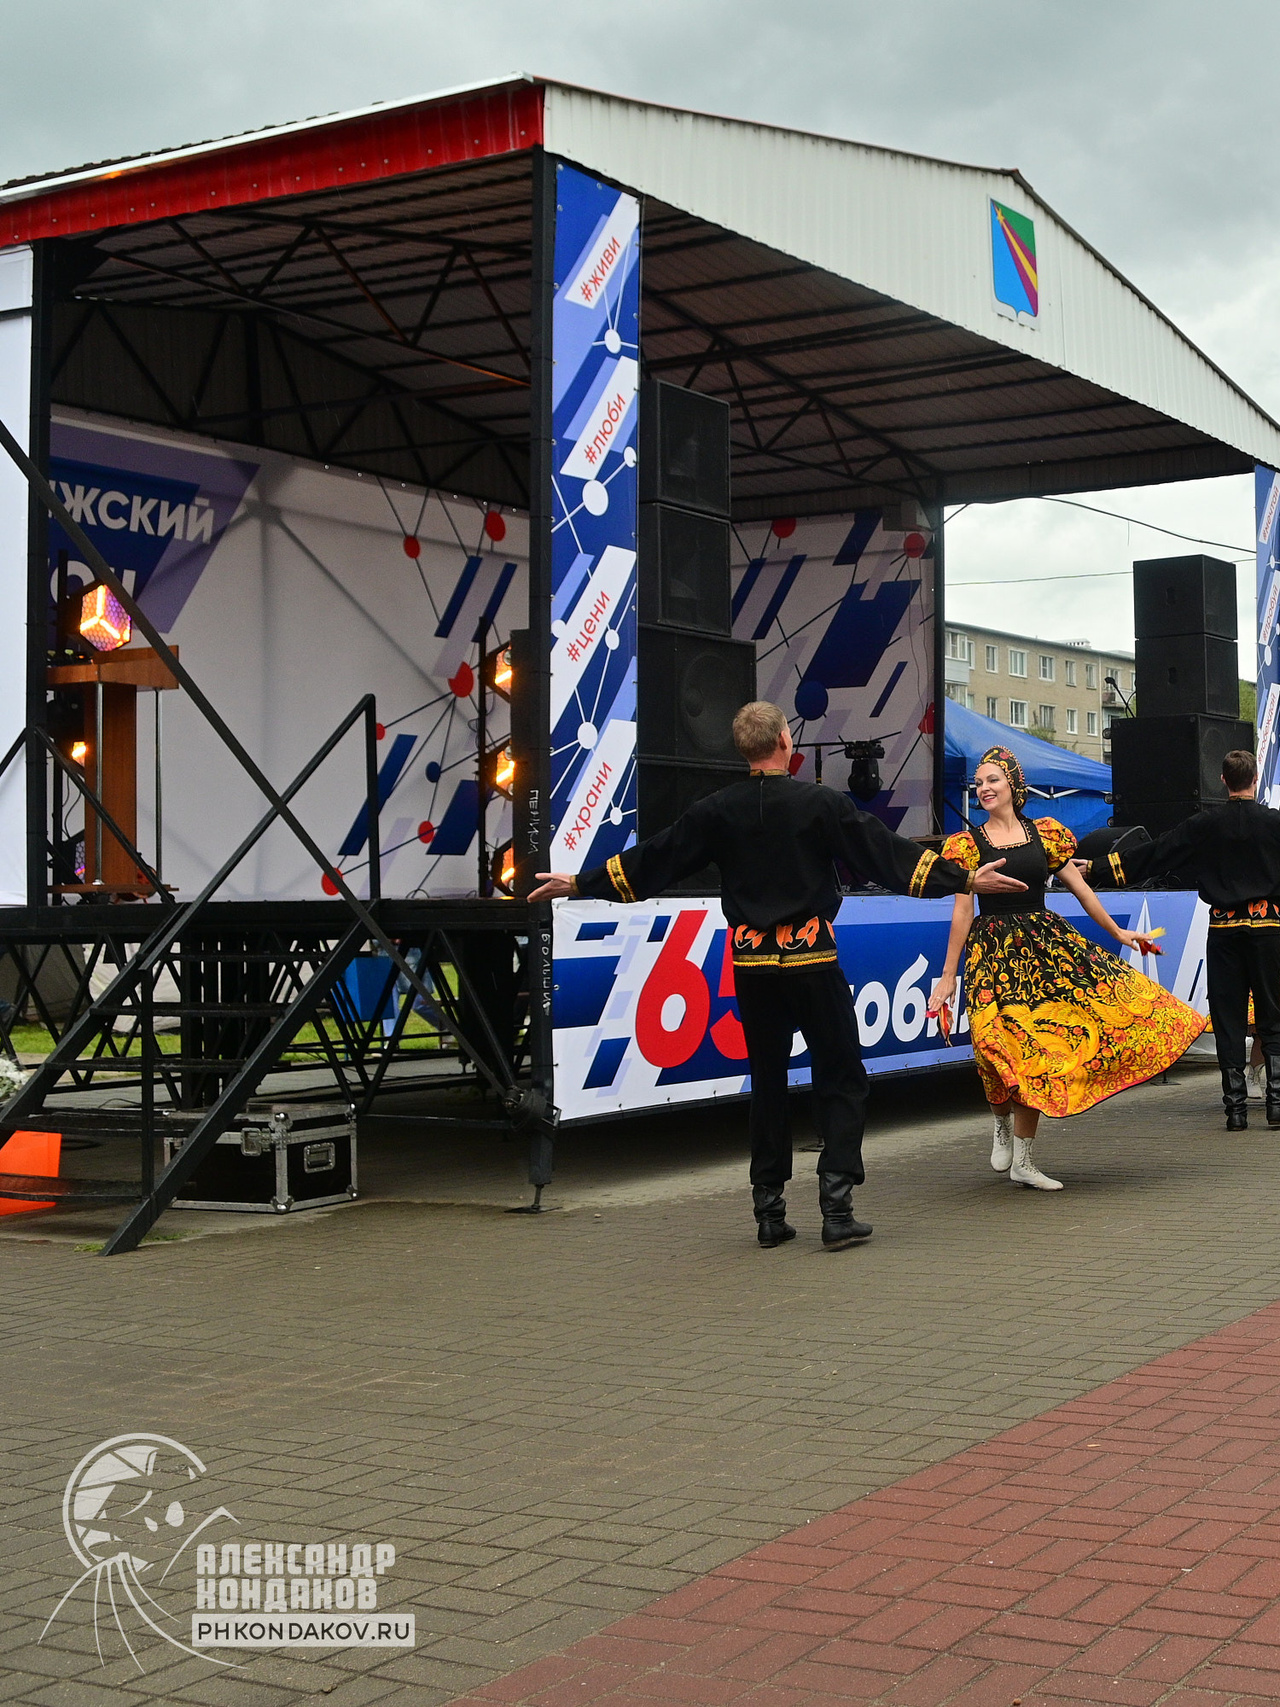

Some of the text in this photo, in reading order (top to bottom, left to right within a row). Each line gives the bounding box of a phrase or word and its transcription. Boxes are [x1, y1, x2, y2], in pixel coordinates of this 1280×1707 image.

[580, 236, 621, 302] #живи
[584, 393, 626, 464] #люби
[49, 479, 214, 544] ЖСКИЙ
[566, 590, 611, 662] #цени
[564, 761, 612, 851] #храни
